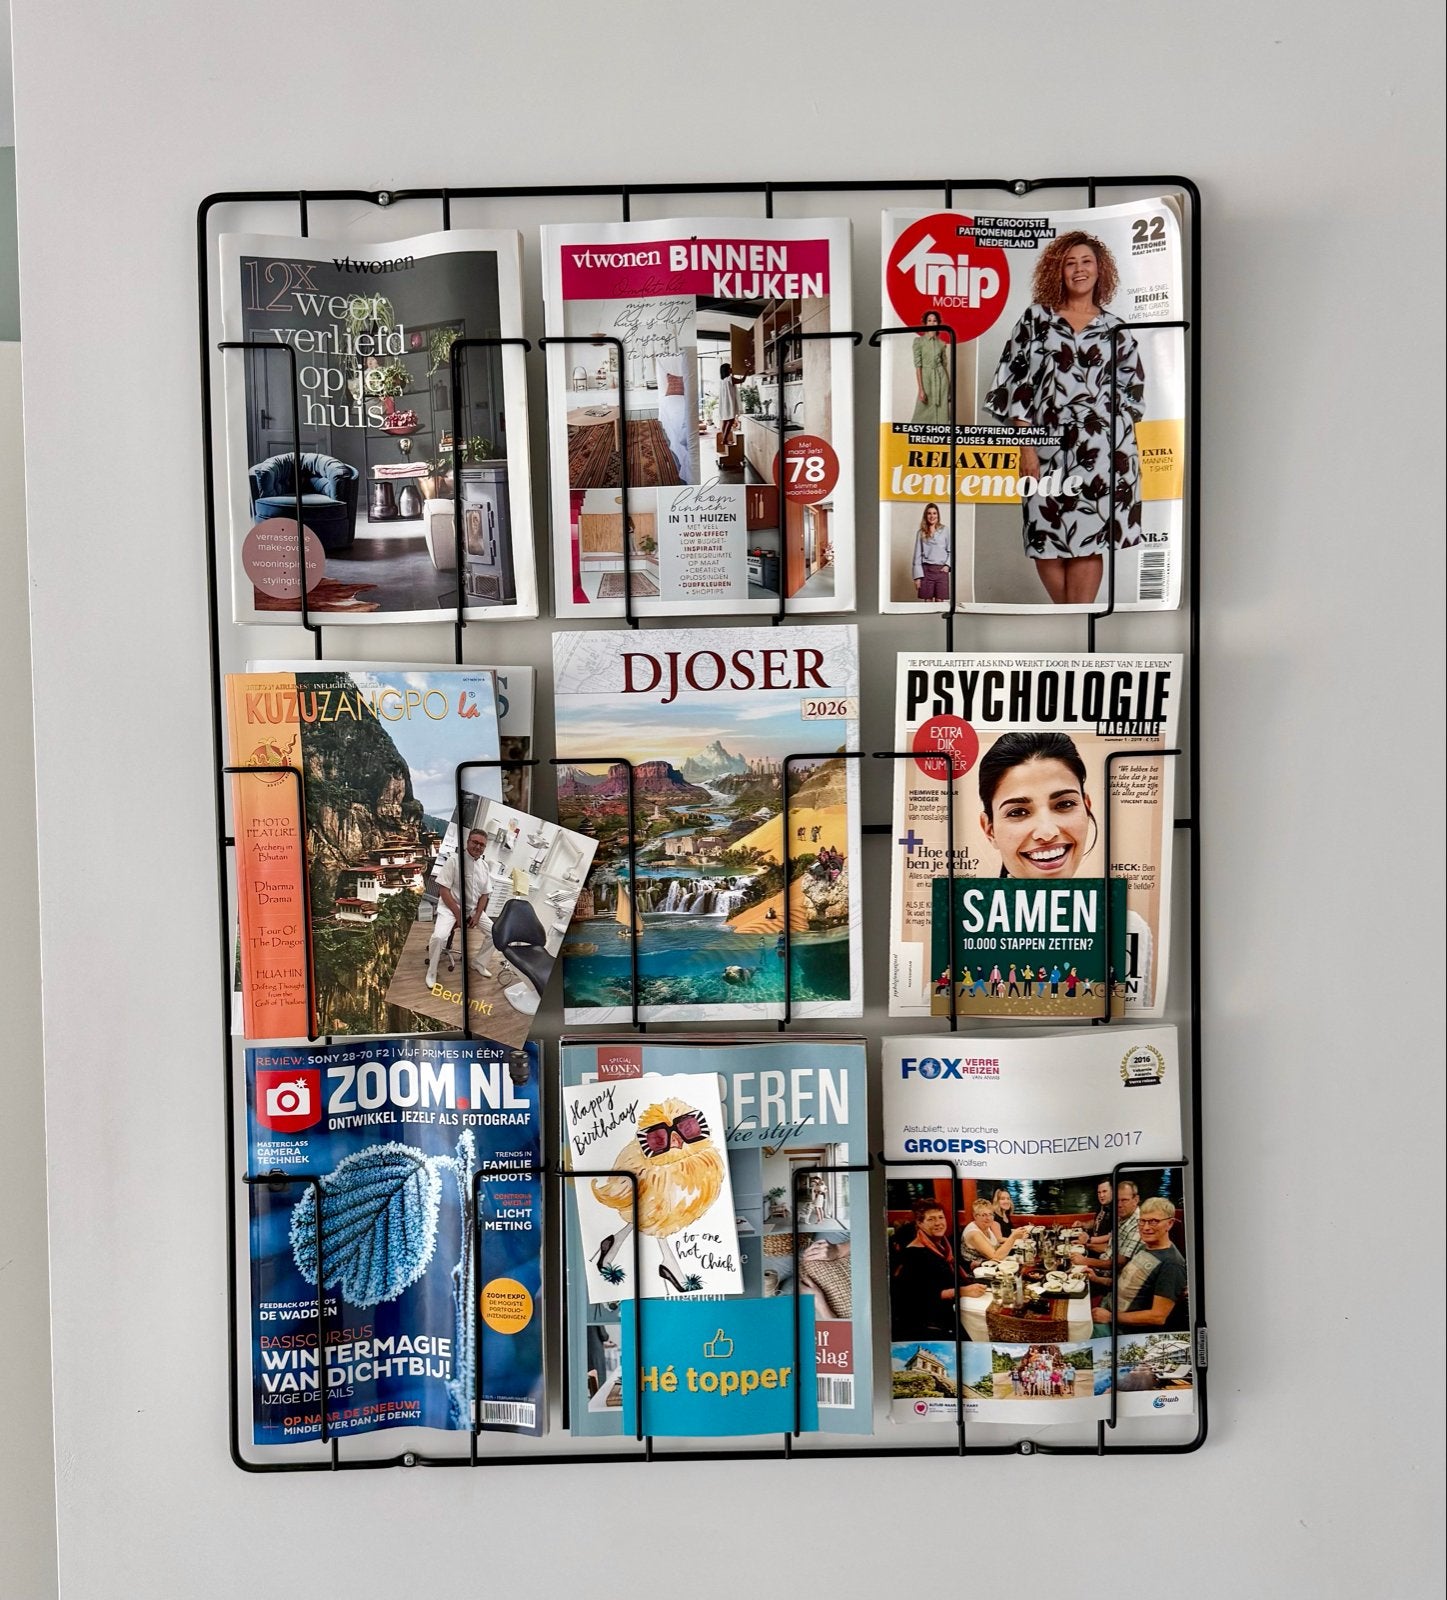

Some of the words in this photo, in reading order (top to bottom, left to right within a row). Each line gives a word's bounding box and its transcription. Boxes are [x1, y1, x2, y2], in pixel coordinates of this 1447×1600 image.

[977, 217, 995, 227] HET
[996, 218, 1046, 229] GROOTSTE
[1131, 216, 1166, 244] 22
[958, 227, 1031, 238] PATRONENBLAD
[1032, 228, 1054, 239] VAN
[979, 238, 1035, 248] NEDERLAND
[1131, 240, 1166, 251] PATRONEN
[332, 255, 415, 274] vtwonen
[572, 249, 662, 268] vtwonen
[669, 245, 788, 271] BINNEN
[713, 273, 823, 299] KIJKEN
[932, 296, 969, 308] MODE
[1134, 292, 1169, 303] BROEK
[291, 292, 386, 321] weer
[270, 324, 408, 356] verliefd
[300, 365, 344, 398] op
[353, 364, 385, 400] je
[902, 425, 924, 434] EASY
[925, 425, 963, 435] SHORS,
[964, 426, 1015, 435] BOYFRIEND
[1016, 426, 1048, 436] JEANS,
[910, 435, 946, 444] TRENDY
[947, 436, 986, 445] BOUSES
[987, 436, 994, 445] &
[995, 436, 1061, 446] STROKENJURK
[1142, 447, 1173, 457] EXTRA
[908, 450, 1017, 470] RELAXTE
[786, 456, 825, 482] 78
[890, 464, 1084, 498] lentemode
[695, 476, 736, 502] kom
[669, 515, 680, 523] IN
[684, 514, 695, 522] 11
[700, 513, 737, 522] HUIZEN
[1140, 532, 1168, 542] NR.5
[976, 659, 992, 667] ALS
[992, 659, 1014, 667] KIND
[1015, 659, 1044, 667] WERKT
[1046, 659, 1070, 667] DOOR
[1117, 660, 1134, 668] VAN
[620, 648, 832, 704] DJOSER
[906, 669, 1171, 722] PSYCHOLOGIE
[246, 688, 449, 725] KUZUZANGPO
[806, 700, 848, 716] 2026
[930, 726, 963, 739] EXTRA
[1098, 721, 1160, 736] MAGAZINE
[937, 738, 956, 751] DIK
[925, 759, 967, 771] NUMER
[252, 817, 290, 828] PHOTO
[246, 828, 297, 837] FEATURE
[917, 846, 943, 858] Hoe
[906, 857, 930, 869] ben
[931, 857, 943, 872] je
[254, 881, 294, 893] Dharma
[258, 893, 292, 905] Drama
[962, 889, 1097, 933] SAMEN
[257, 926, 281, 936] Tour
[282, 925, 297, 935] Of
[250, 938, 269, 948] The
[963, 937, 997, 950] 10.000
[1000, 937, 1046, 950] STAPPEN
[1048, 937, 1094, 951] ZETTEN?
[256, 969, 282, 979] HUA
[283, 968, 303, 978] HIN
[431, 982, 494, 1016] Bednkt
[256, 1056, 306, 1066] REVIEW:
[307, 1053, 339, 1065] SONY
[342, 1050, 373, 1062] 28-70
[376, 1048, 389, 1058] F2
[397, 1047, 420, 1058] VIJF
[422, 1048, 460, 1059] PRIMES
[461, 1050, 473, 1059] IN
[476, 1047, 504, 1059] ÉÉN?
[601, 1064, 641, 1073] WONEN
[901, 1058, 964, 1080] FOX
[965, 1058, 999, 1066] VERRE
[962, 1067, 1000, 1075] REIZEN
[327, 1060, 530, 1115] ZOOM.NL
[570, 1085, 617, 1127] Happy
[328, 1110, 397, 1131] ONTWIKKEL
[400, 1112, 436, 1125] JEZELF
[438, 1113, 459, 1126] ALS
[462, 1112, 531, 1126] FOTOGRAAF
[572, 1100, 639, 1156] Birthday
[960, 1125, 999, 1134] brochure
[904, 1134, 1100, 1155] GROEPSRONDREIZEN
[1104, 1131, 1143, 1149] 2017
[256, 1148, 301, 1156] CAMERA
[256, 1155, 310, 1165] TECHNIEK
[483, 1159, 532, 1170] FAMILIE
[482, 1172, 532, 1182] SHOOTS
[496, 1208, 533, 1219] LICHT
[485, 1221, 532, 1231] METING
[683, 1231, 699, 1243] to
[702, 1232, 723, 1243] one
[676, 1241, 701, 1259] hot
[701, 1254, 737, 1273] Chick
[259, 1301, 298, 1309] FEEDBACK
[310, 1298, 336, 1307] FOO'S
[259, 1311, 277, 1321] DE
[261, 1335, 452, 1371] WINTERMAGIE
[262, 1371, 320, 1393] VAN
[327, 1356, 452, 1389] DICHTBIJ!
[640, 1365, 678, 1393] Hé
[686, 1366, 792, 1397] topper
[261, 1393, 301, 1405] IJZIGE
[303, 1385, 355, 1402] DEAILS
[283, 1416, 302, 1427] OP
[344, 1409, 360, 1420] DE
[362, 1400, 421, 1417] SNEEUW!
[327, 1420, 349, 1430] VER
[350, 1416, 372, 1427] DAN
[373, 1414, 386, 1423] JE
[388, 1410, 422, 1421] DENKT
